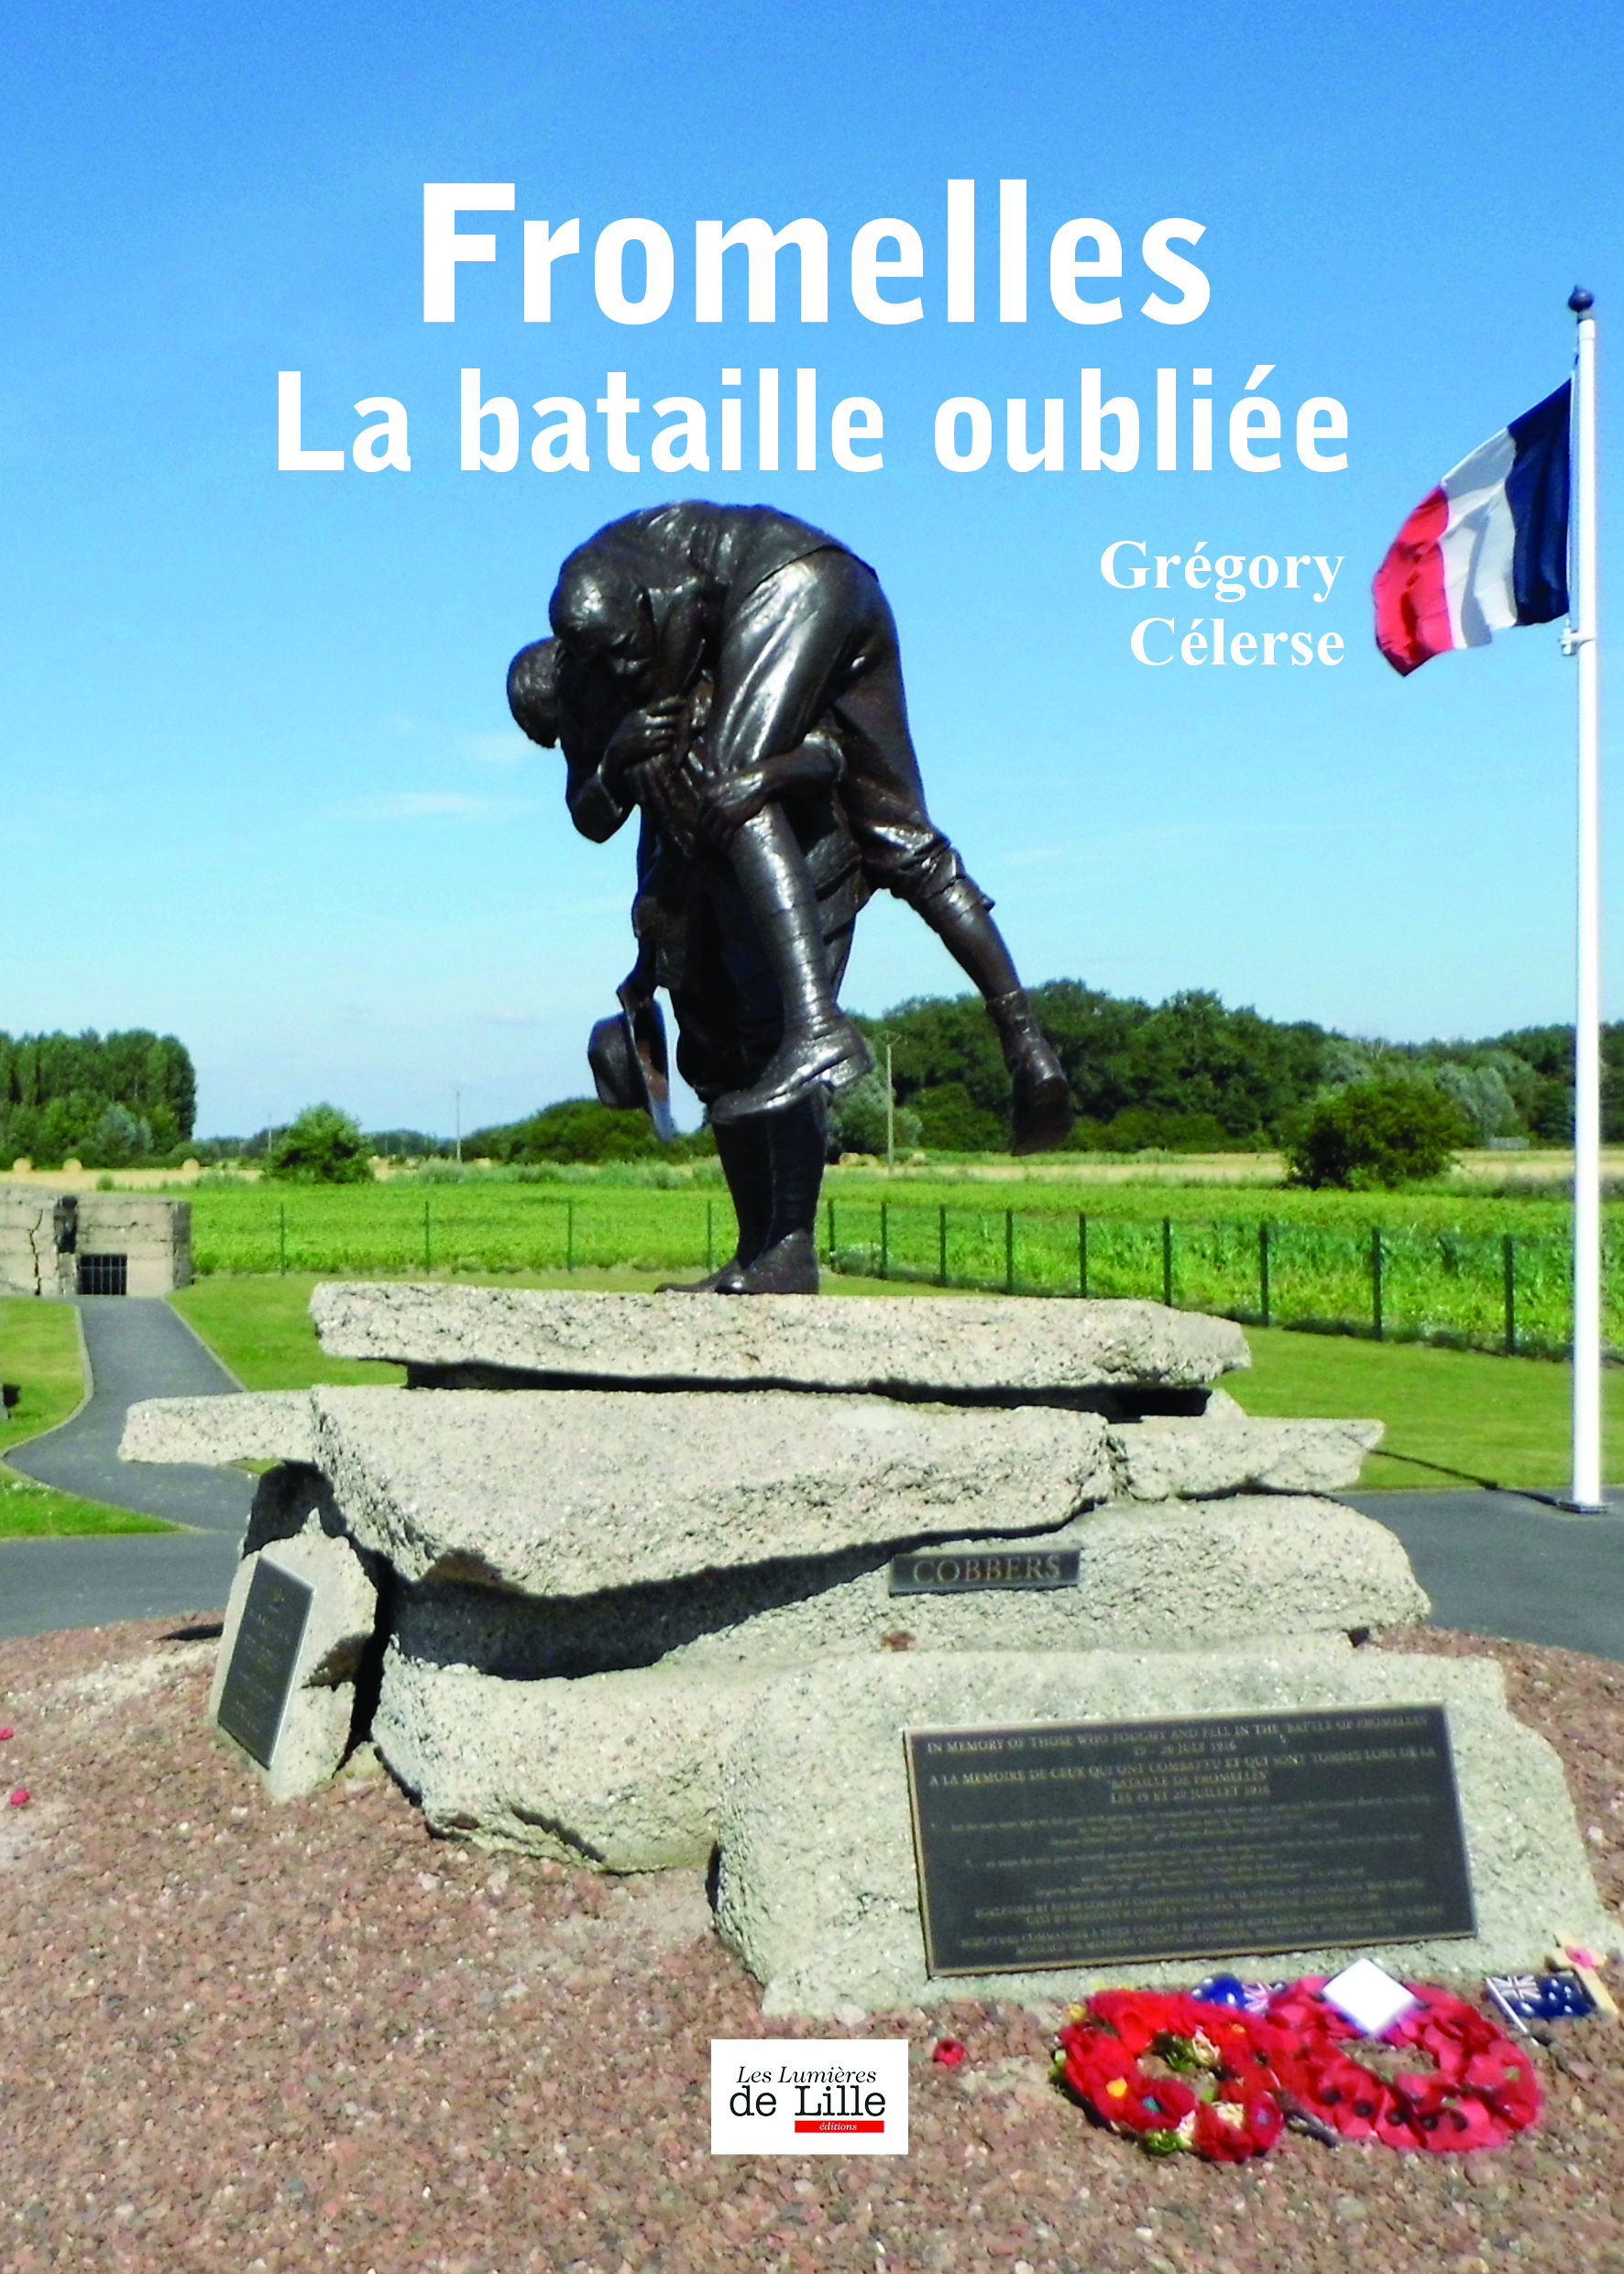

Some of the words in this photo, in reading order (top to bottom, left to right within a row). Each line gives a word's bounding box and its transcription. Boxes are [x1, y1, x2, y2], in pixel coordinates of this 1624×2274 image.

[914, 1554, 1061, 1583] COBBERS
[927, 1741, 942, 1753] IN
[946, 1739, 1004, 1752] MEMORY
[1006, 1738, 1024, 1749] OF
[1028, 1735, 1073, 1748] THOSE
[1075, 1732, 1109, 1745] WHO
[1169, 1728, 1198, 1740] AND
[1234, 1725, 1249, 1735] IN
[1253, 1723, 1278, 1734] THE
[1286, 1720, 1332, 1732] BATTLE
[927, 1774, 938, 1785] A
[940, 1773, 959, 1785] LA
[1088, 1764, 1113, 1778] QUI
[1244, 1755, 1268, 1768] QUI
